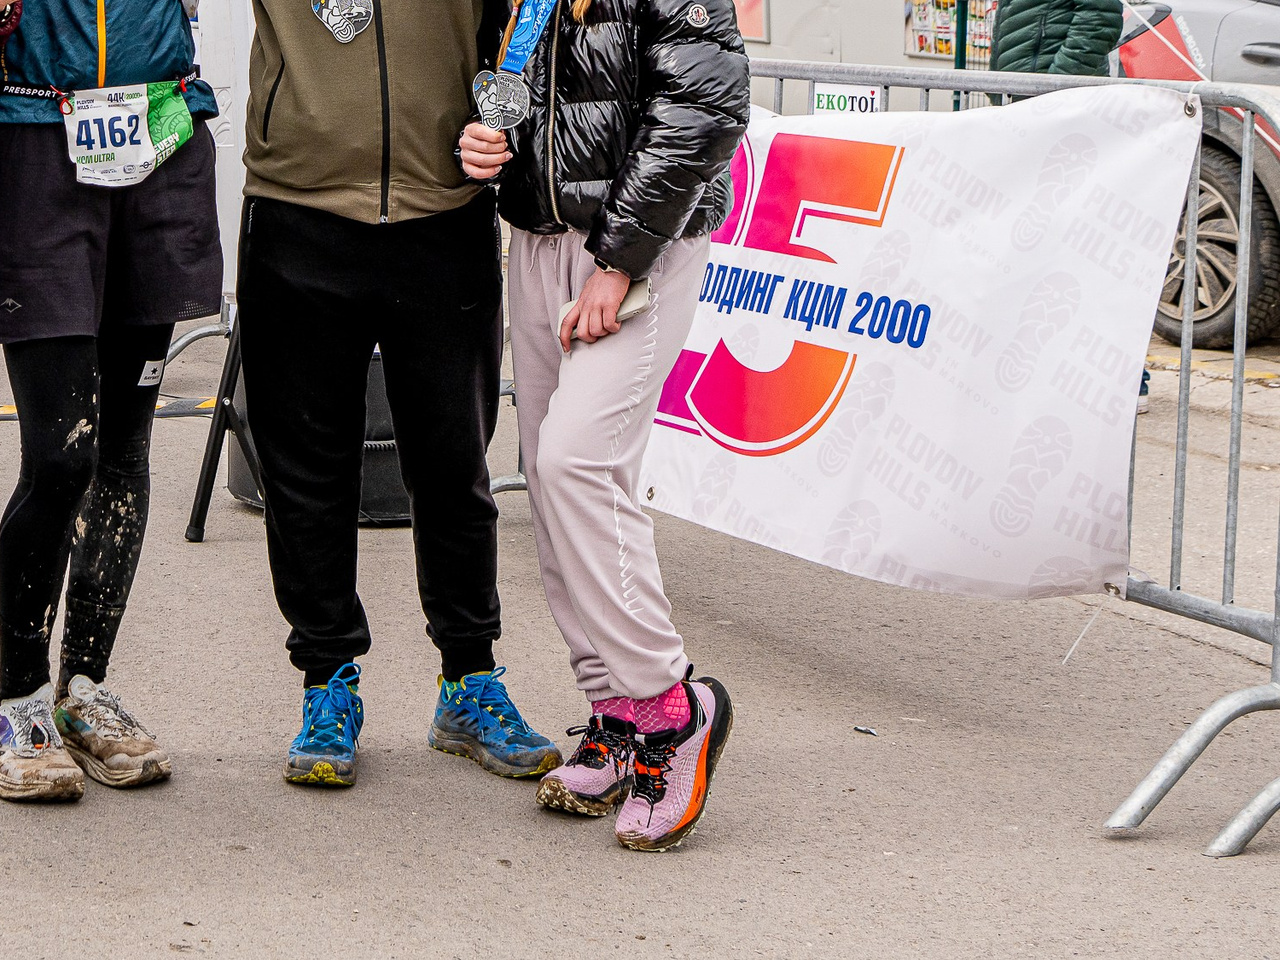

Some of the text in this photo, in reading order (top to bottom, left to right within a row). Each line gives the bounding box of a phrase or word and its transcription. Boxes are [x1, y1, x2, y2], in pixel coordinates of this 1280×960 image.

[3, 86, 57, 98] PRESSPORT
[107, 92, 125, 103] 44K
[76, 115, 141, 150] 4162
[93, 153, 115, 163] ULTRA
[154, 132, 179, 153] EVERY
[901, 178, 962, 232] HILLS
[919, 148, 1012, 221] PLOVDIV
[1083, 184, 1175, 258] PLOVDI
[1061, 217, 1136, 281] HILLS
[699, 262, 931, 349] ОЛДИНГ КЦМ 2000
[1069, 324, 1141, 392] PLOV
[938, 367, 999, 416] MARKOVO
[1049, 359, 1127, 427] HILLS
[865, 445, 931, 512] HILLS
[884, 412, 984, 501] PLOVDIV
[929, 510, 1001, 558] MARKOVO
[1053, 505, 1129, 553] HILL
